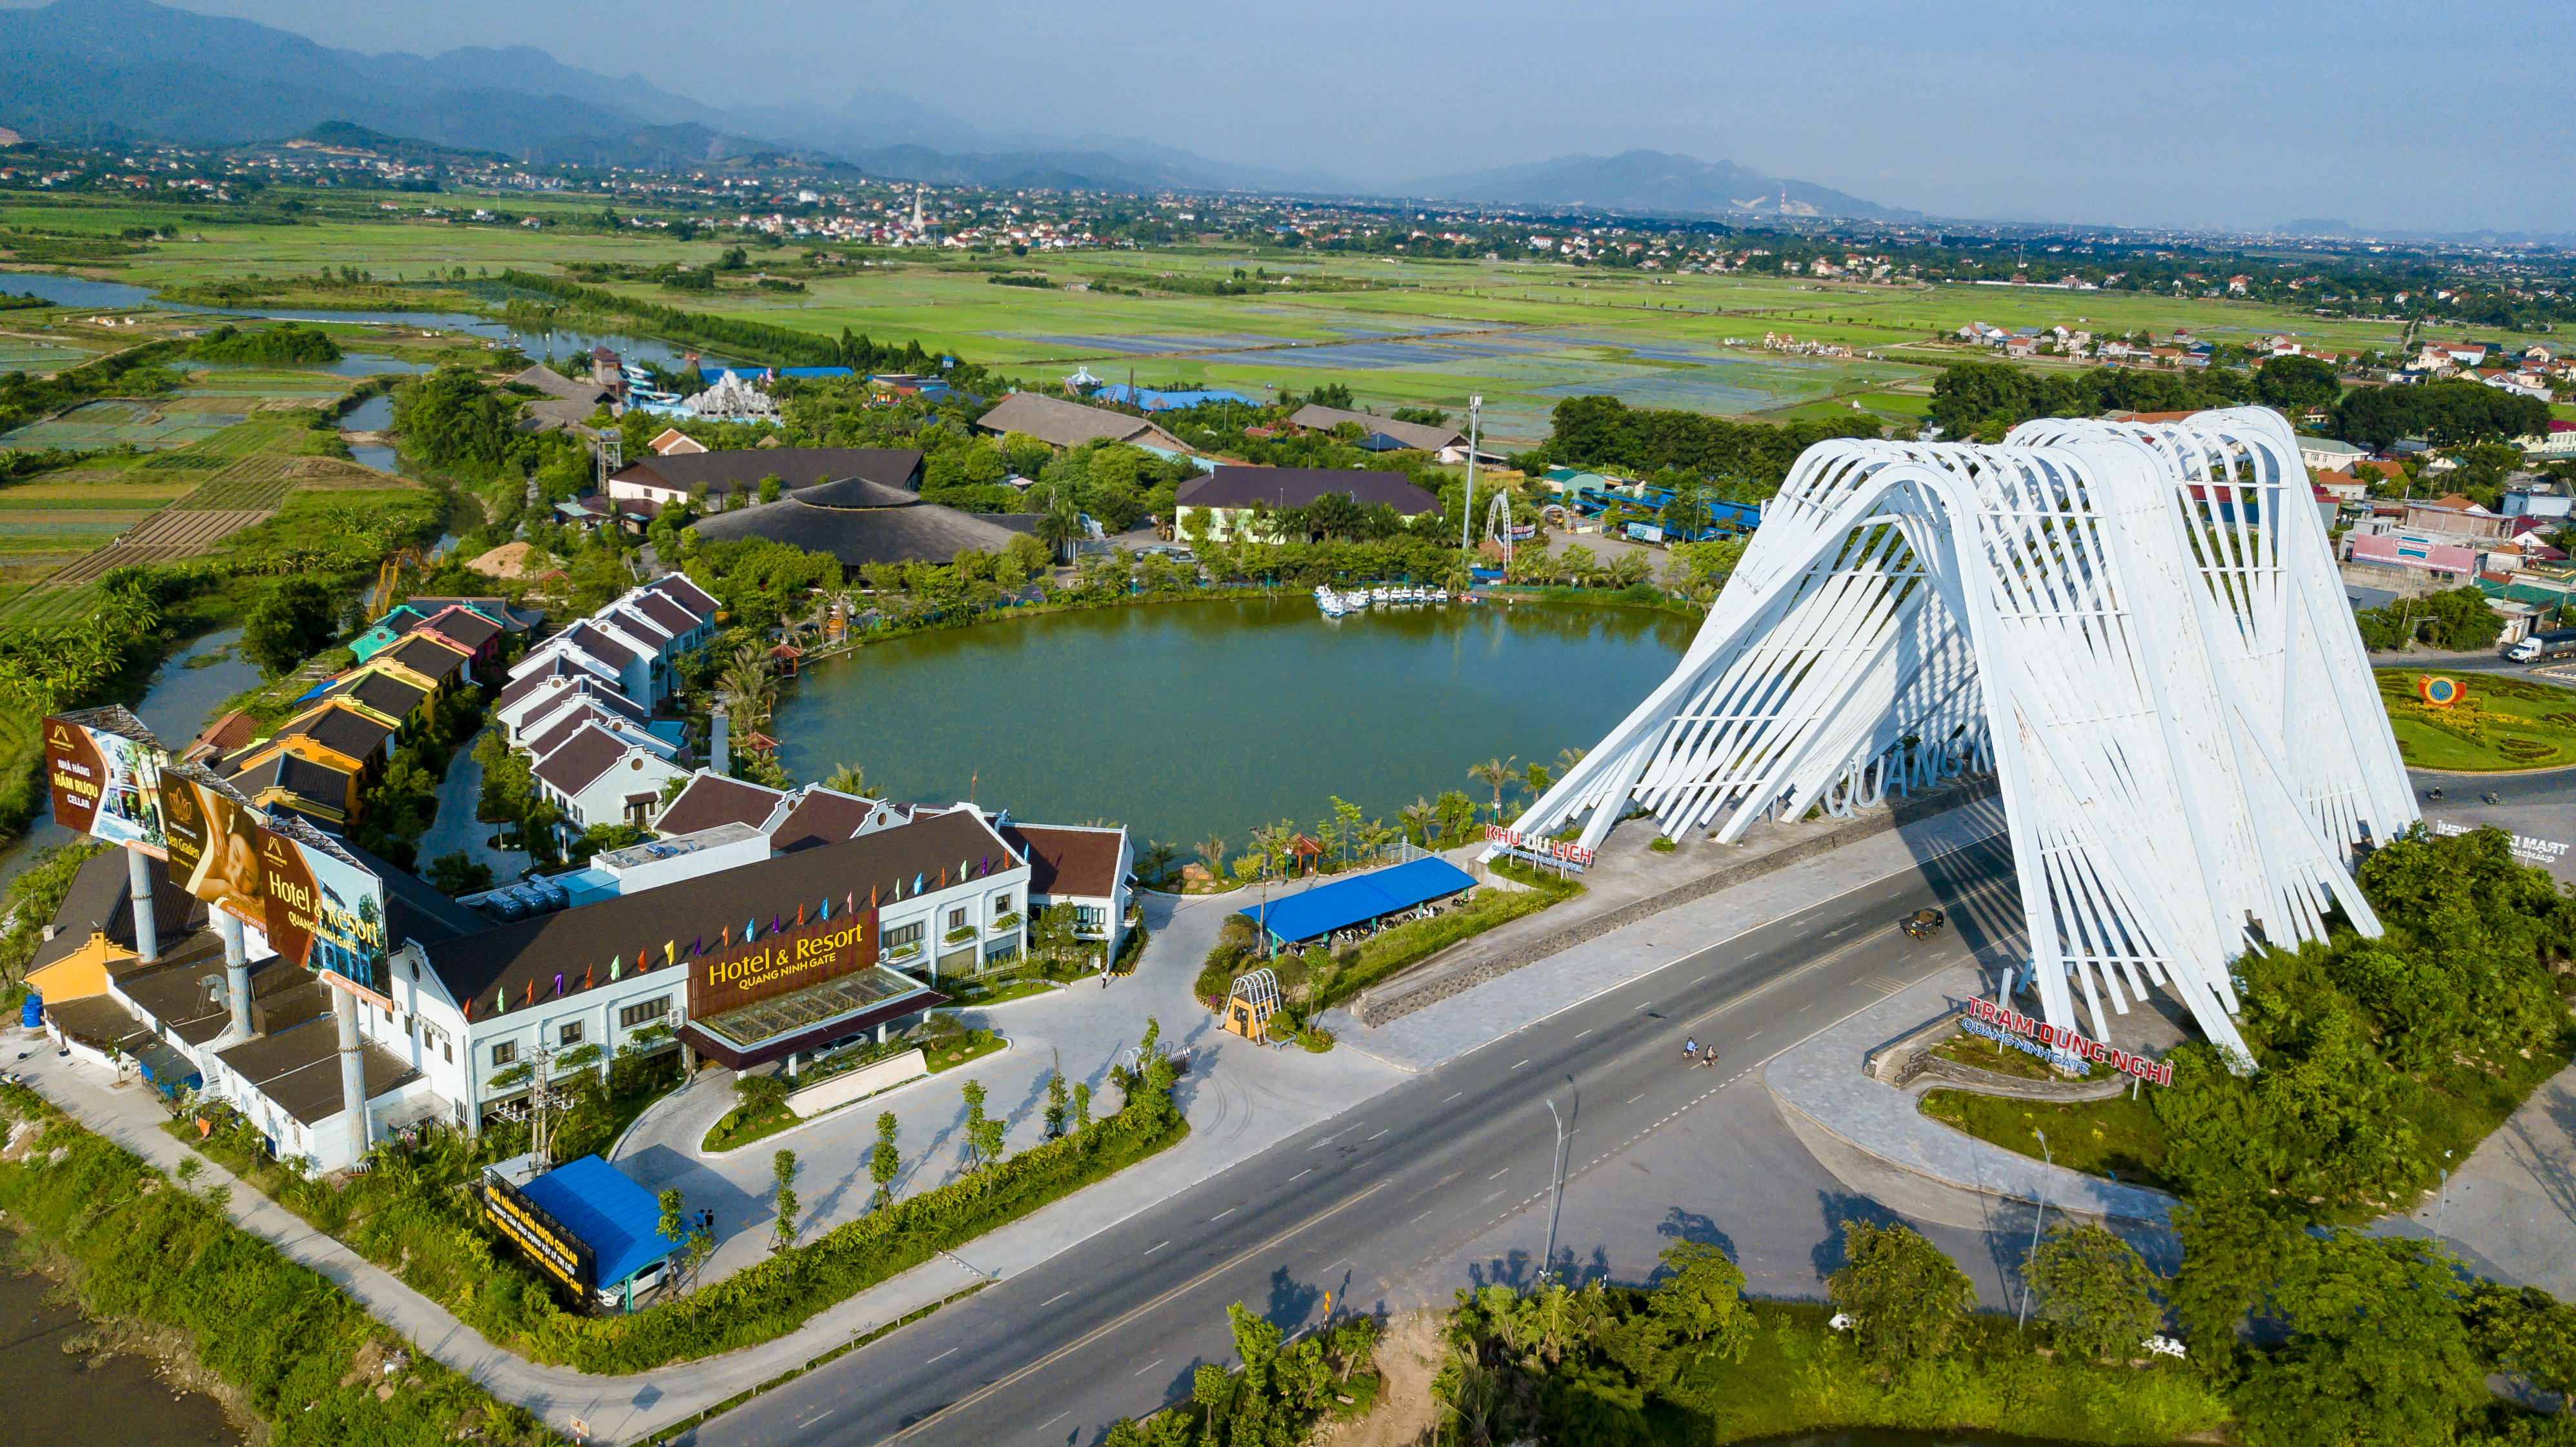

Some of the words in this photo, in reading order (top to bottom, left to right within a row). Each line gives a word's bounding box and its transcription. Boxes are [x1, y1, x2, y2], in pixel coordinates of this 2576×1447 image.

[72, 763, 90, 777] HÀNG
[75, 780, 98, 800] RƯỢU
[1826, 738, 1964, 818] QUẢNG
[67, 794, 90, 809] CELLAR
[166, 832, 178, 849] Sen
[179, 838, 199, 860] Graden
[1485, 824, 1521, 847] KHU
[1525, 833, 1549, 853] DU
[1492, 844, 1517, 856] QUANG
[1518, 850, 1536, 860] NINH
[1538, 856, 1558, 866] GATE
[1558, 860, 1584, 873] HOTEL
[269, 870, 310, 913] Hotel
[314, 899, 323, 917] &
[327, 898, 379, 947] Resort
[288, 911, 316, 933] QUANG
[315, 925, 336, 944] NINH
[336, 936, 357, 955] GATE
[710, 947, 770, 986] Hotel
[776, 949, 789, 966] &
[797, 924, 863, 960] Resort
[739, 969, 779, 990] QUANG
[781, 961, 807, 977] NINH
[809, 953, 836, 968] GATE
[1962, 1018, 2014, 1046] QUANG
[2015, 1039, 2050, 1060] NINH
[2051, 1050, 2091, 1075] GATE
[2039, 1022, 2106, 1064] DỪNG
[2110, 1047, 2173, 1087] NGHỈ
[487, 1184, 501, 1204] NHÀ
[501, 1195, 519, 1218] HÀNG
[536, 1223, 554, 1246] RƯỢU
[555, 1239, 578, 1267] CELLAR
[492, 1202, 507, 1219] TRUNG
[507, 1214, 516, 1228] TÂM
[517, 1221, 527, 1236] ỨNG
[527, 1231, 541, 1248] DỤNG
[541, 1242, 551, 1255] VẬT
[551, 1250, 557, 1260] LÝ
